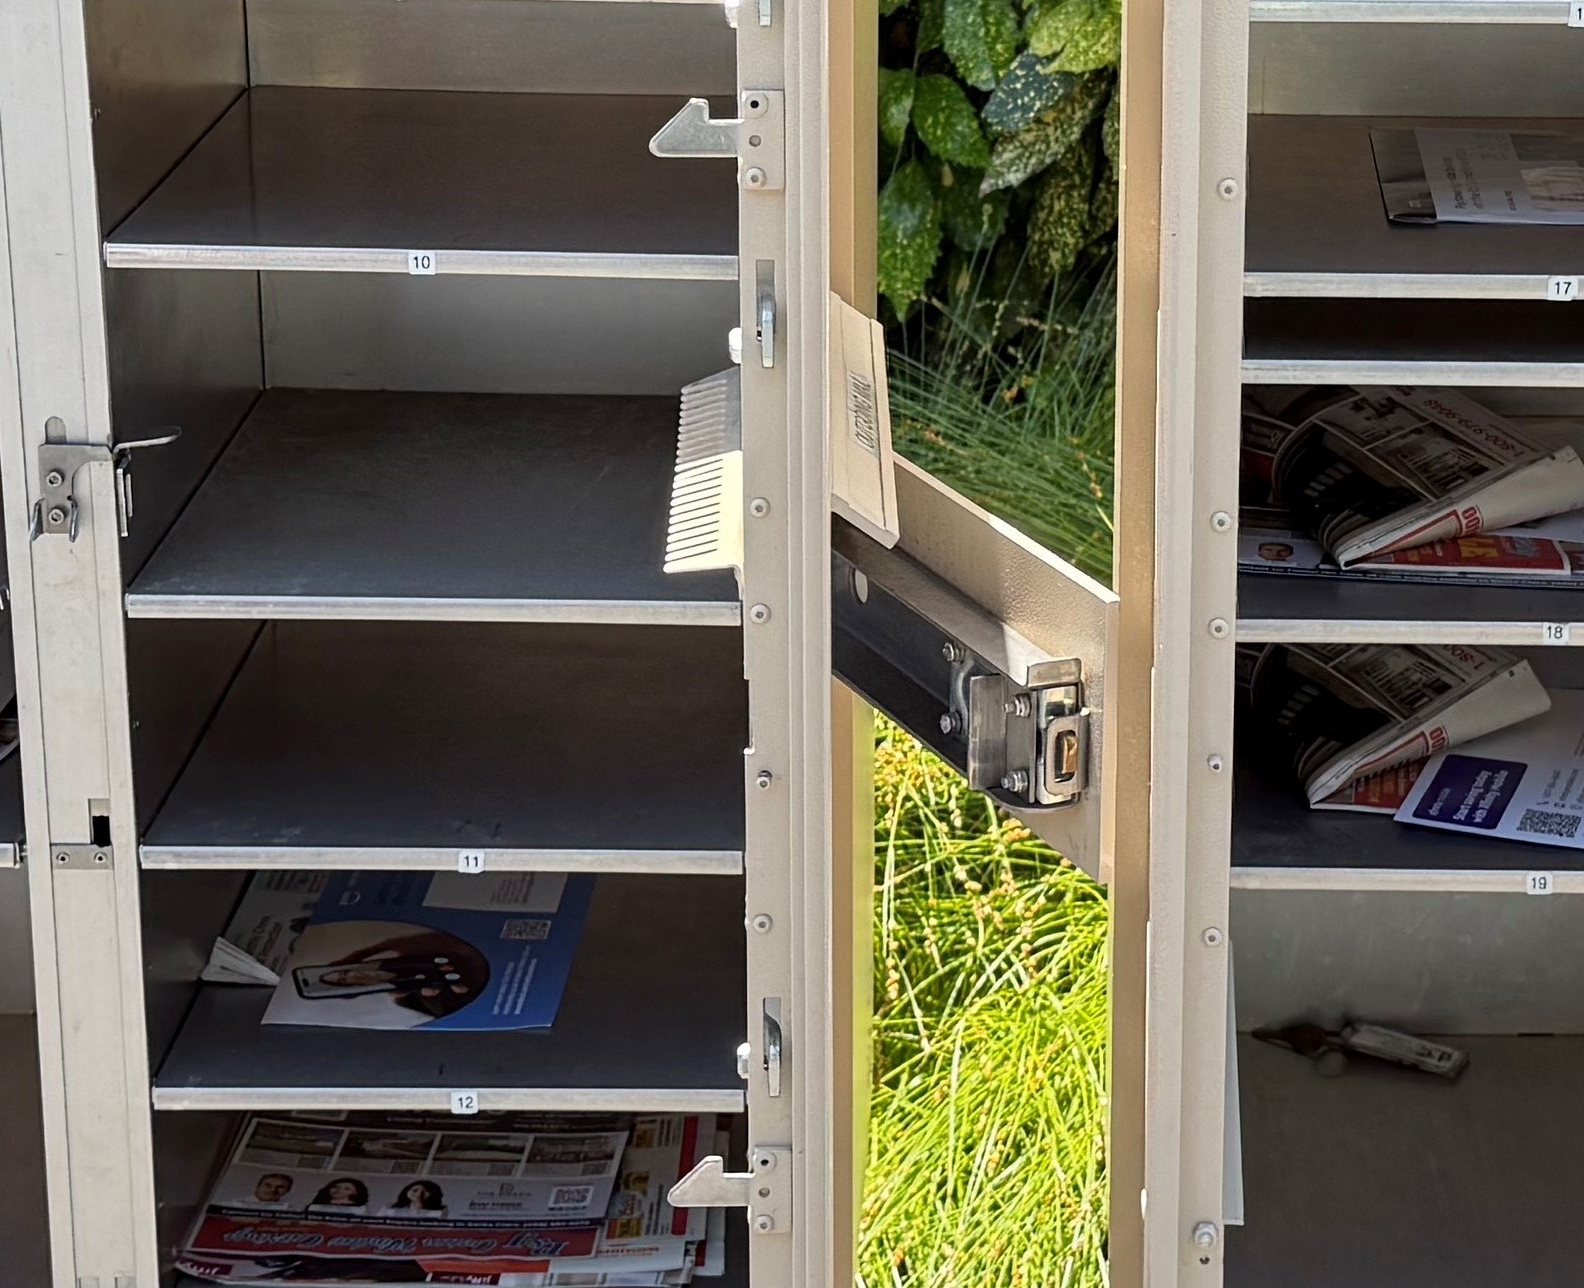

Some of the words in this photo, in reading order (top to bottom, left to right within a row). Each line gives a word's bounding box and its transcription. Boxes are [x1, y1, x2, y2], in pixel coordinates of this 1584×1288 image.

[413, 255, 431, 270] 10
[1554, 281, 1572, 295] 17
[1547, 625, 1563, 640] 18
[464, 855, 479, 868] 11
[1531, 876, 1548, 890] 19
[457, 1095, 474, 1109] 12
